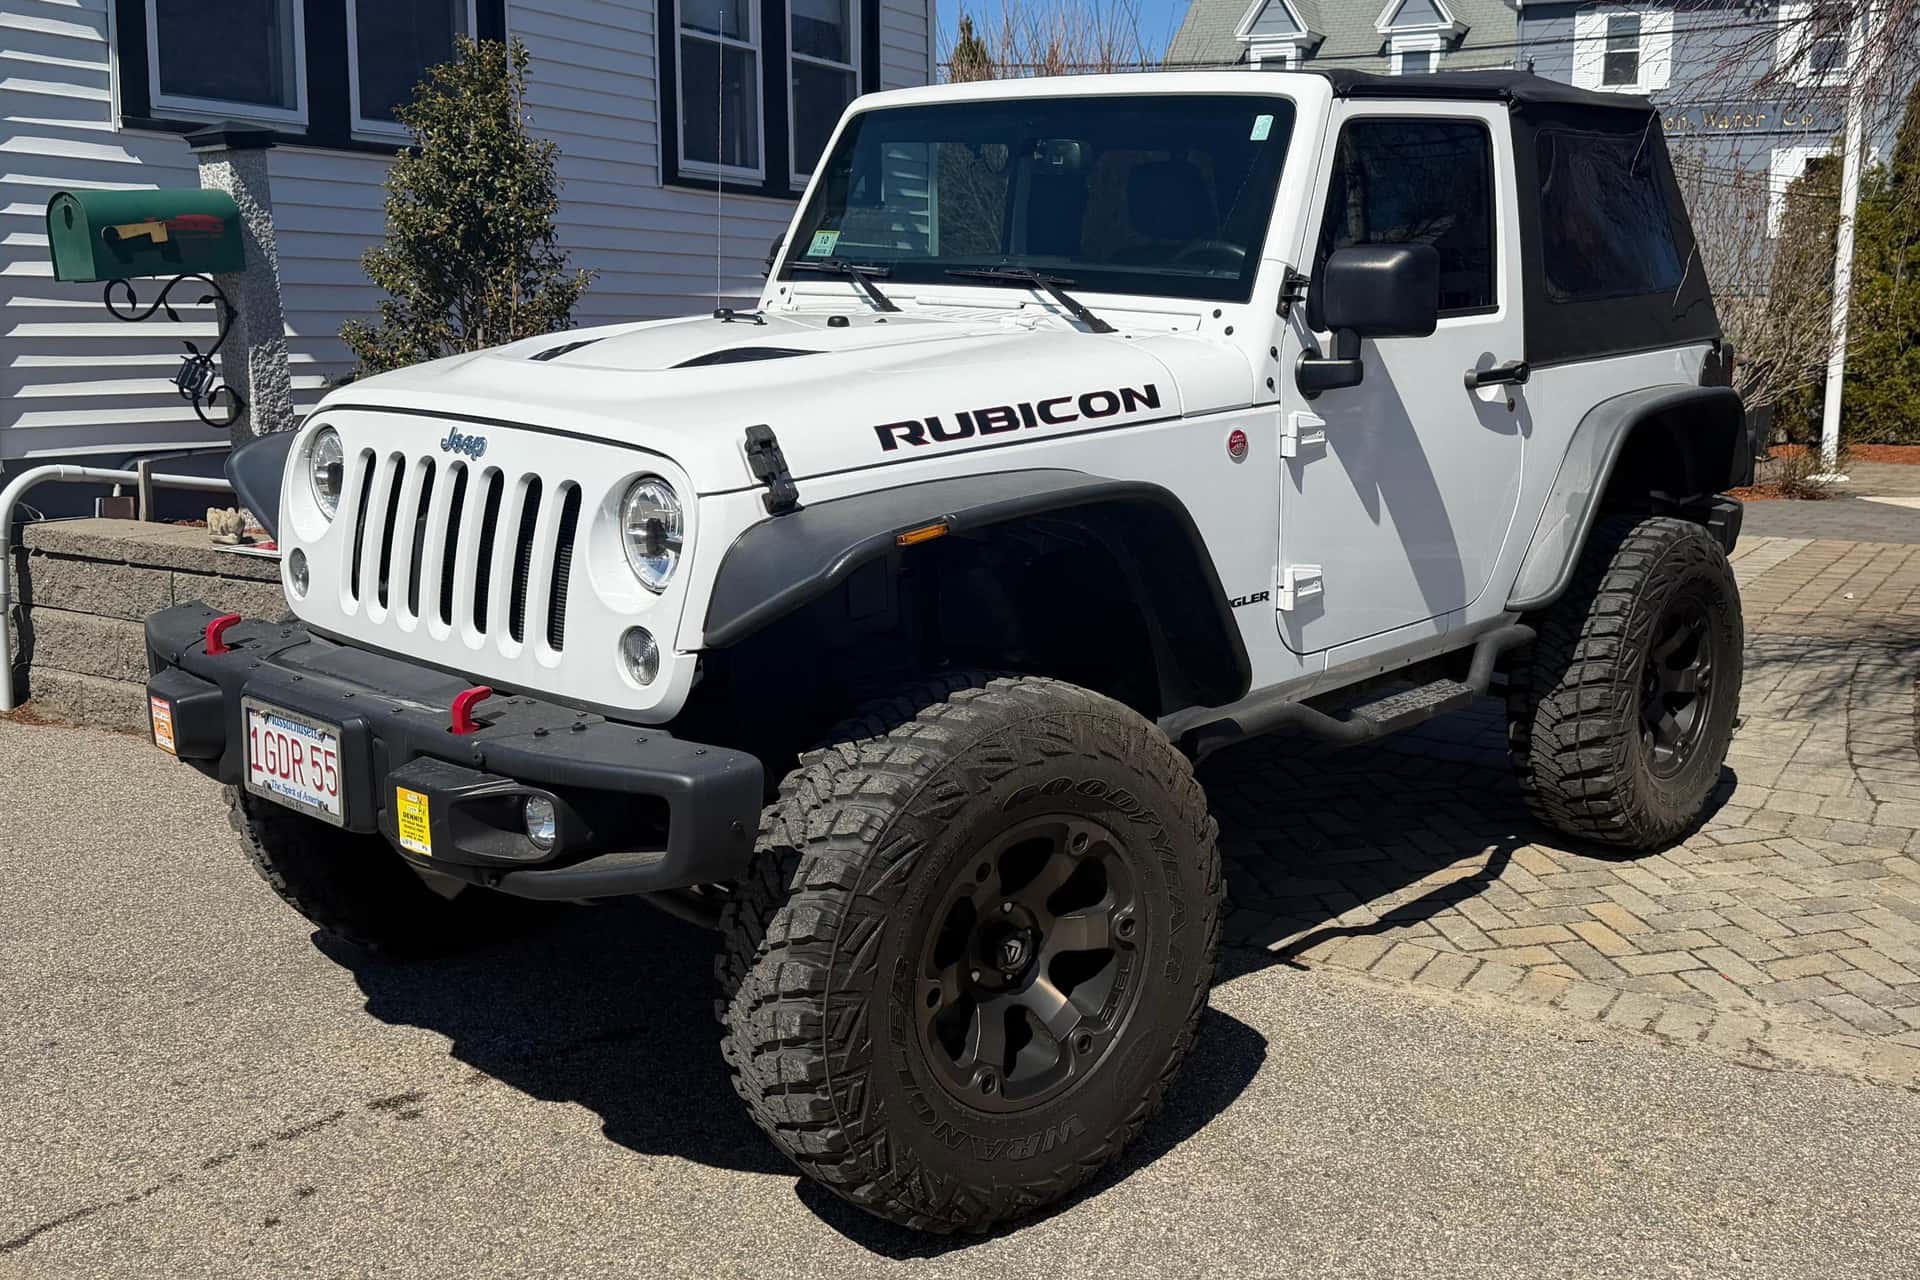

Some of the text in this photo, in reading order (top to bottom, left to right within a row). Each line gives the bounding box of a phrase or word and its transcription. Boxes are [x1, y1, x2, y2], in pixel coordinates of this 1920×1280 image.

[873, 383, 1161, 451] RUBICON
[440, 426, 488, 461] Jeep
[1230, 590, 1270, 608] GLER
[251, 726, 338, 797] 1GDR 55
[271, 779, 281, 790] The
[1002, 776, 1188, 984] GOODYEAR
